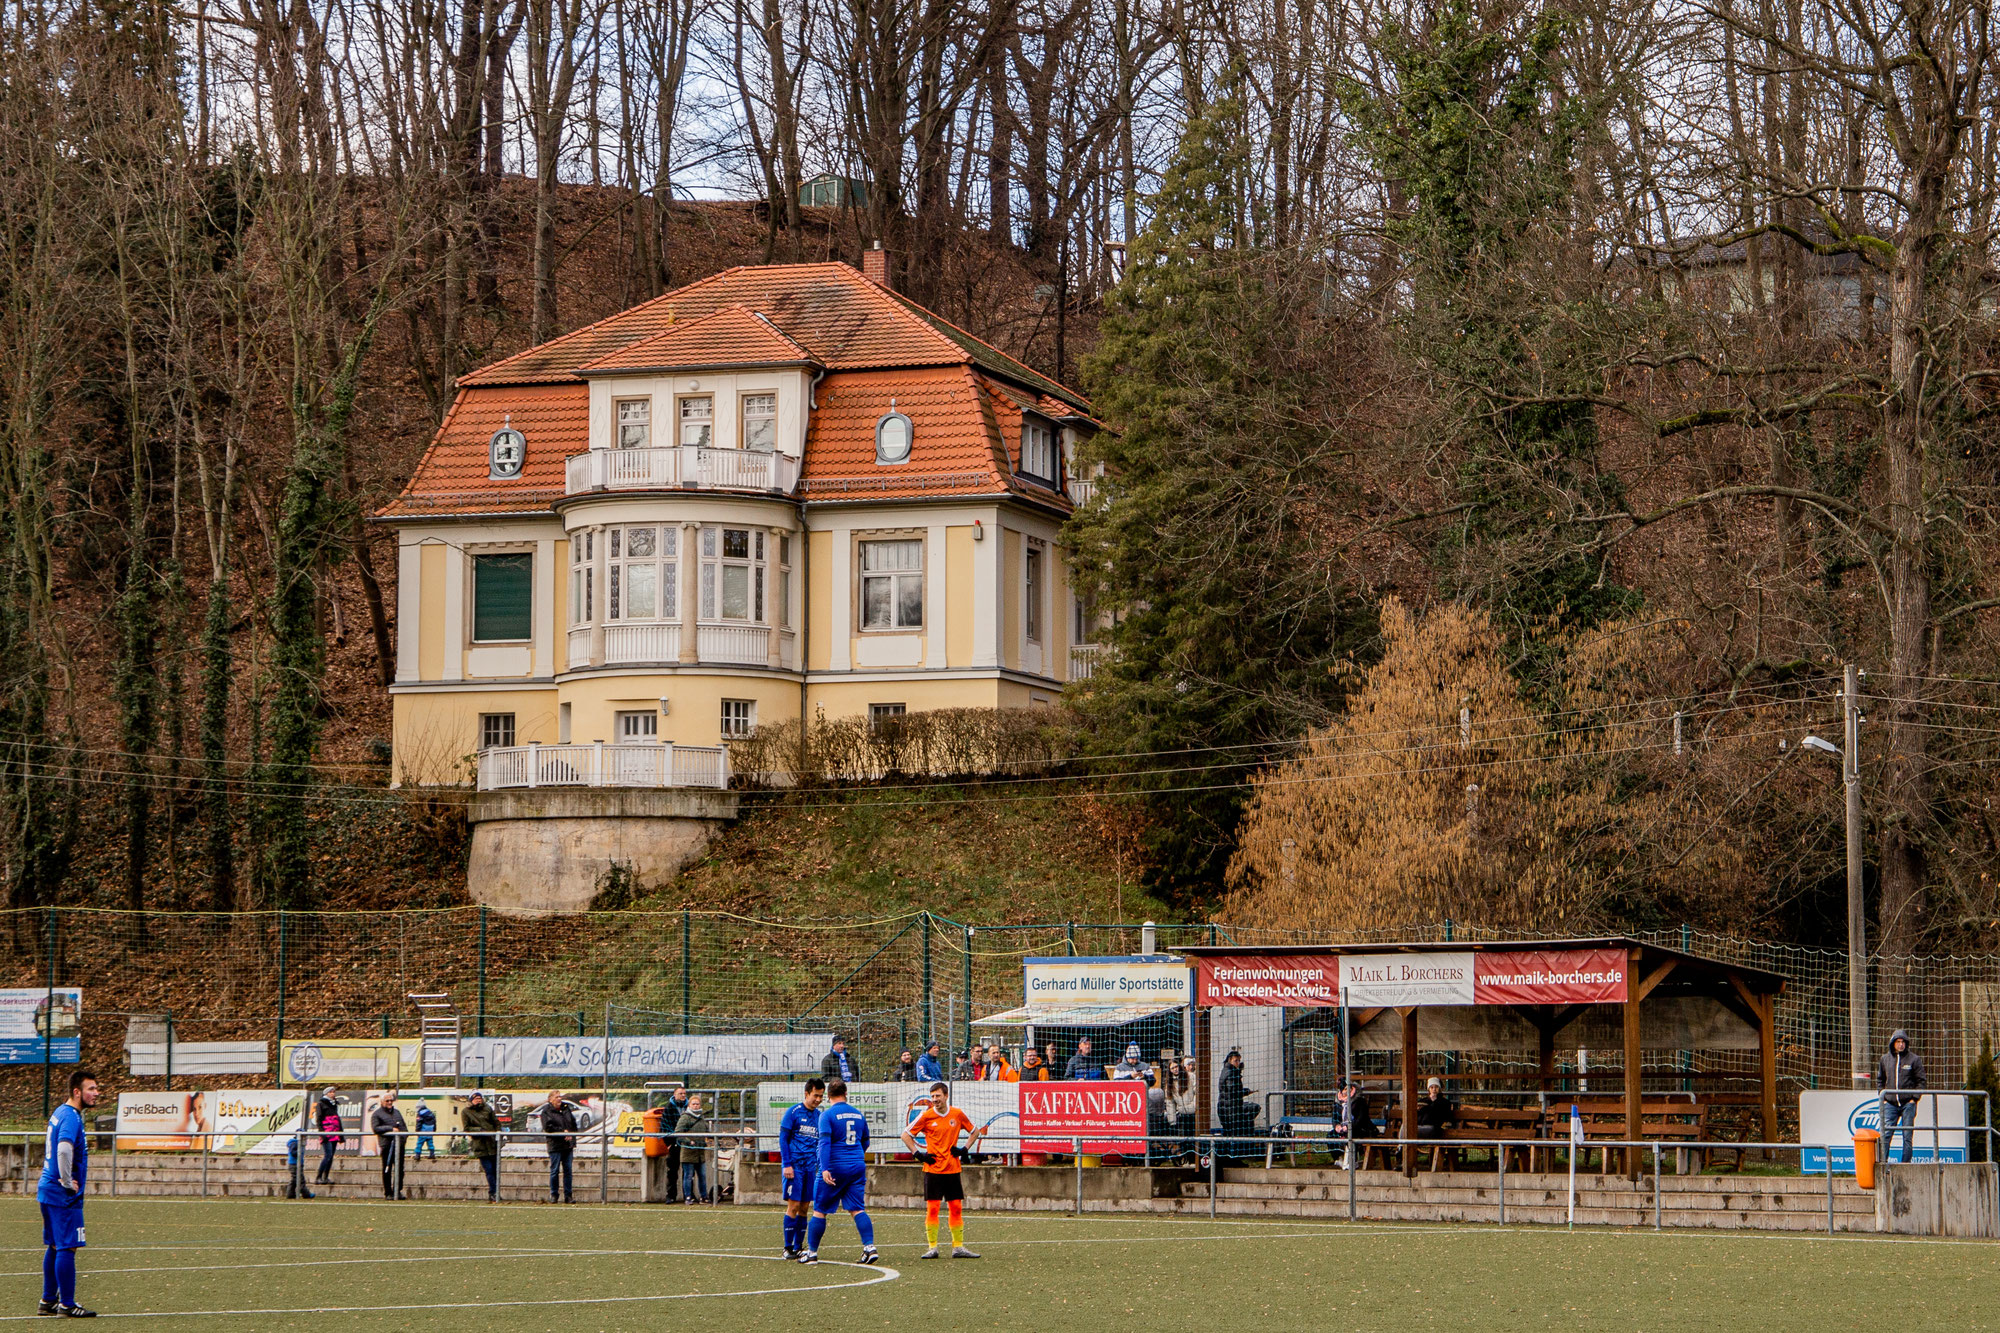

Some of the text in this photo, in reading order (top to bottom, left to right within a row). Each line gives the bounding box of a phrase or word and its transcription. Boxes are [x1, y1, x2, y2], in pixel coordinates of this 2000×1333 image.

[1213, 966, 1323, 983] Ferienwohnungen
[1350, 964, 1463, 982] MAIK L. BORCHERS
[1479, 968, 1622, 985] www.maik-borchers.de
[1031, 976, 1184, 993] Gerhard Müller Sportstätte
[1207, 983, 1331, 997] in Dresden-Lockwitz
[546, 1043, 695, 1071] BSV Sport Parkour
[218, 1099, 270, 1119] Bäckerei
[1023, 1090, 1142, 1115] KAFFANERO
[1023, 1119, 1043, 1127] Rösterei
[1086, 1119, 1106, 1128] Führung
[1109, 1119, 1142, 1128] Veranstaltung
[845, 1120, 856, 1145] 6
